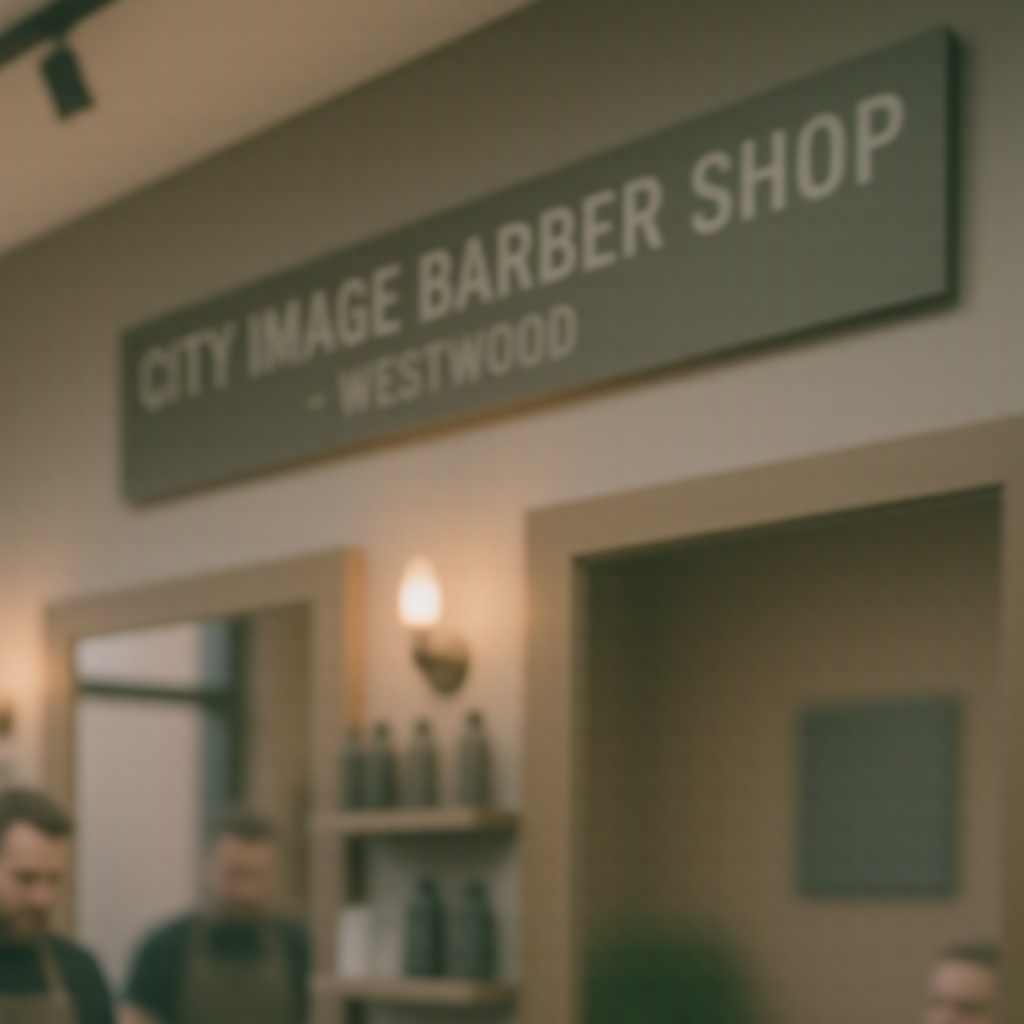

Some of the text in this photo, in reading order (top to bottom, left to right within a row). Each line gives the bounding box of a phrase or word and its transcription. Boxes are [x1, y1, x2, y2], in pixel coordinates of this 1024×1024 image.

[137, 92, 905, 412] CITY IMAGE BARBER SHOP
[338, 305, 578, 416] WESTWOOD
